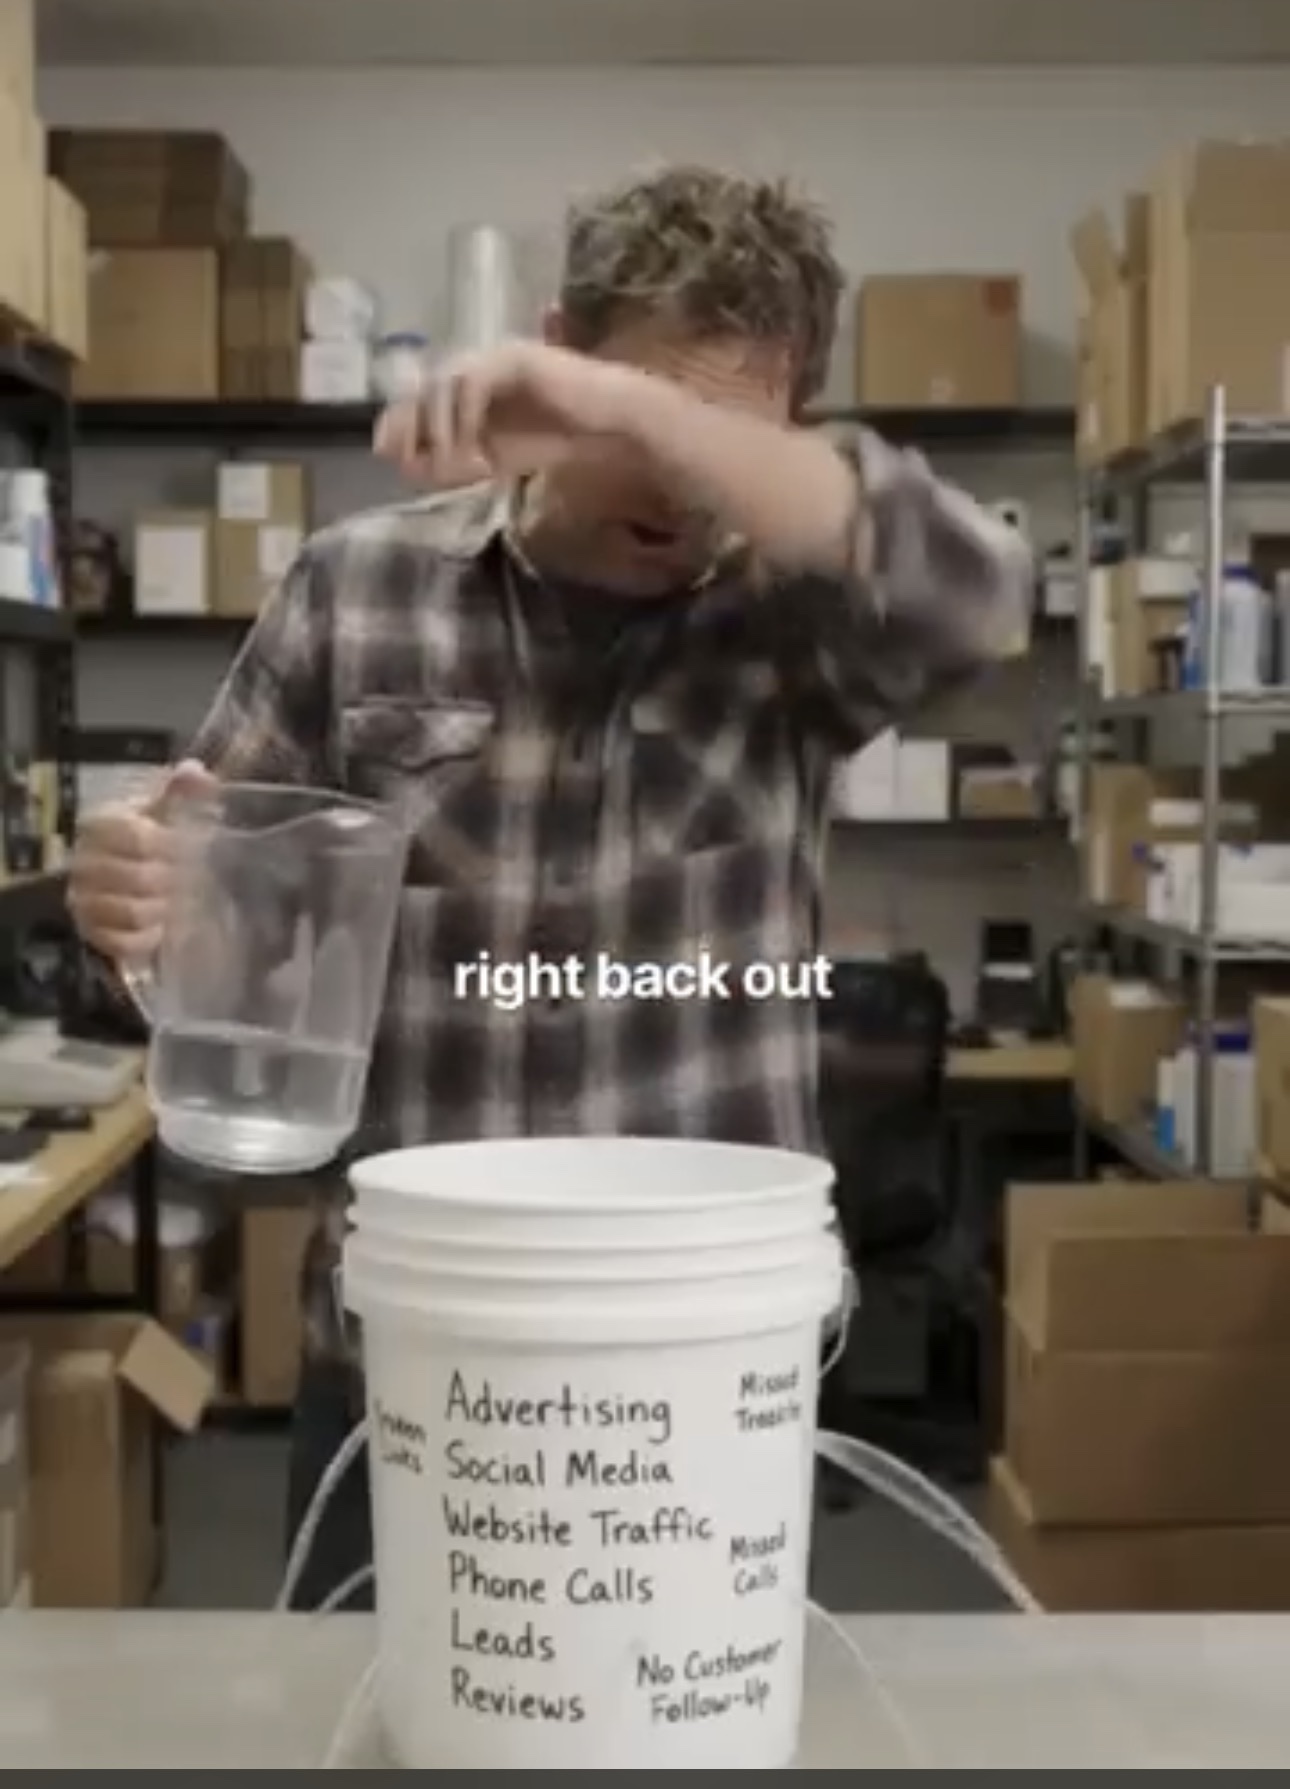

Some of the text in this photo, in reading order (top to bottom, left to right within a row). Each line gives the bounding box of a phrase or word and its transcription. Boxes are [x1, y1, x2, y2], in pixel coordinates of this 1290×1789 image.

[446, 1370, 671, 1444] Advertising
[445, 1439, 545, 1487] Social
[566, 1450, 673, 1486] Media
[443, 1495, 712, 1546] Website Traffic
[449, 1550, 653, 1605] Phone Calls
[451, 1609, 555, 1662] Leads
[637, 1639, 782, 1687] No Customer
[451, 1666, 585, 1722] Reviews
[648, 1679, 770, 1723] Follow-Up
